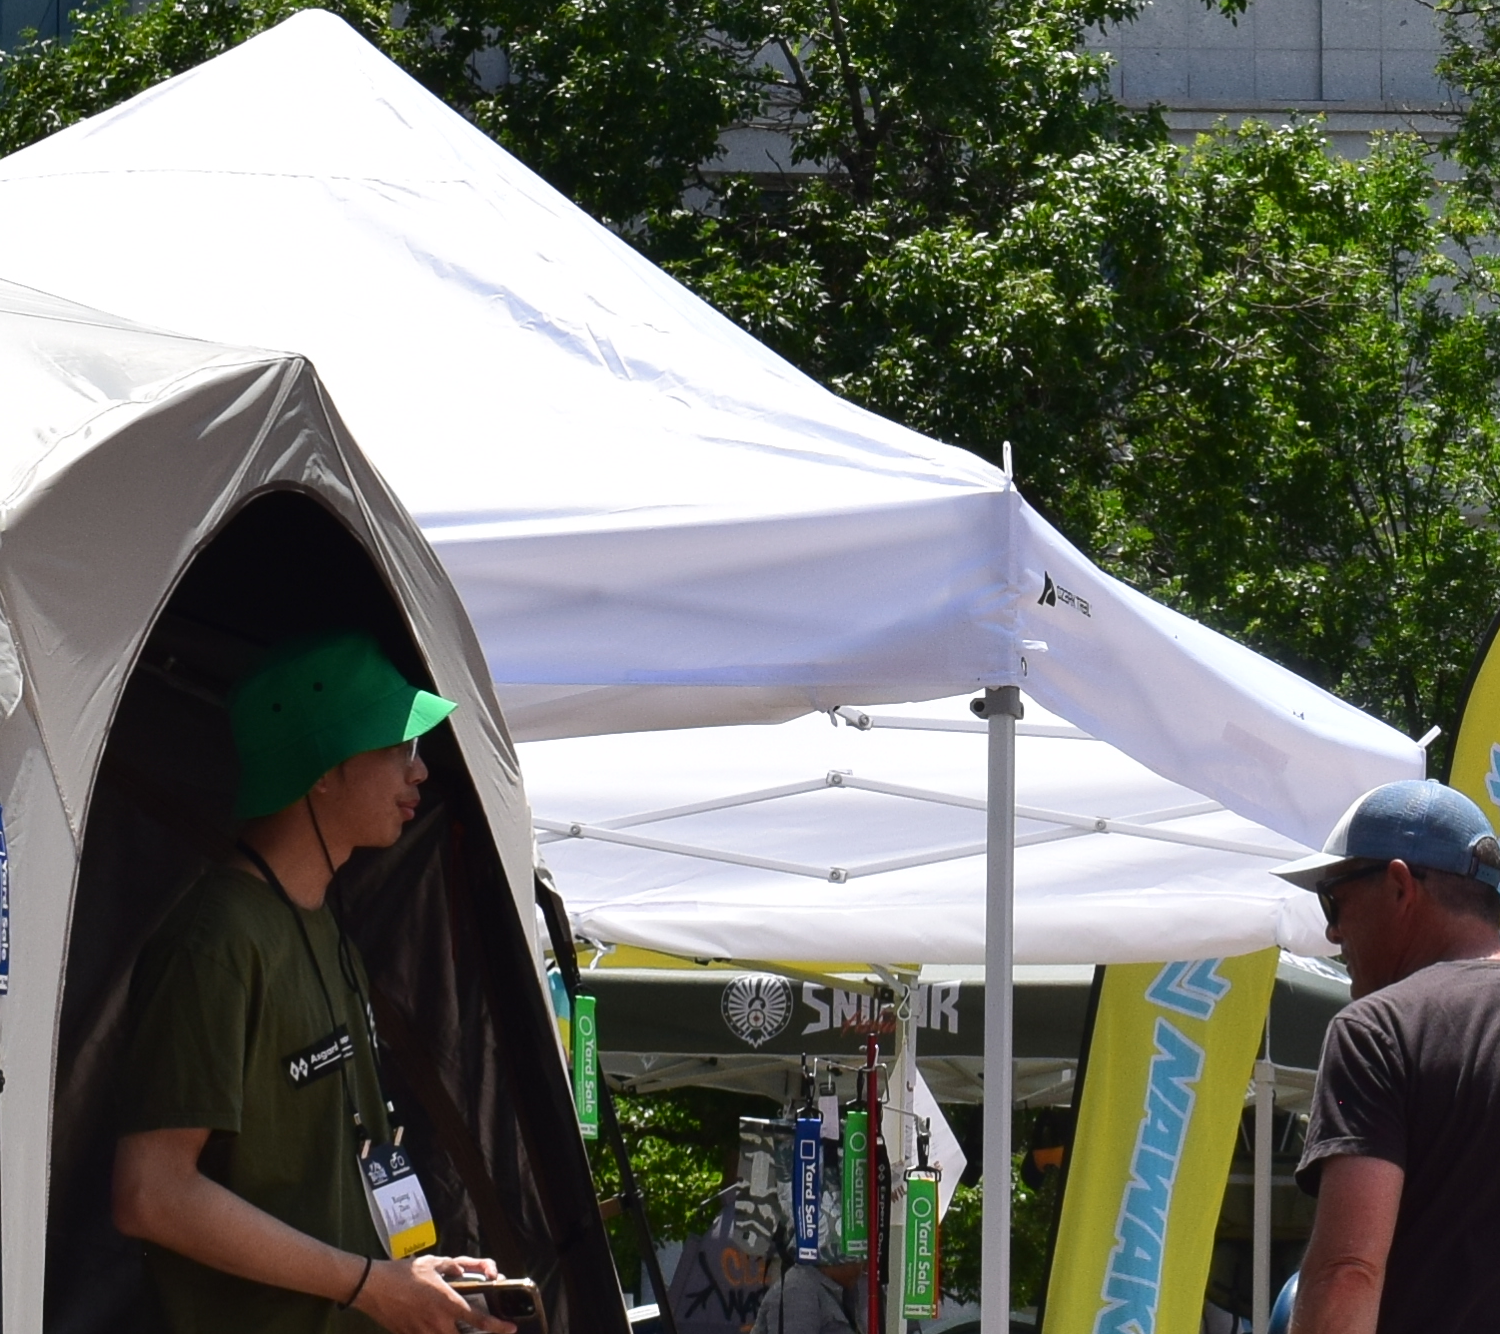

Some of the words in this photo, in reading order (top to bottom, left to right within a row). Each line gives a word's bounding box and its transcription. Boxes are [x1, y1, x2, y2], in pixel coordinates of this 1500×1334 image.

[0, 856, 9, 910] Yard
[0, 918, 9, 961] Sale
[585, 1038, 595, 1076] Yard
[584, 1079, 594, 1115] Sale
[804, 1162, 817, 1200] Yard
[854, 1158, 867, 1228] Learner
[802, 1203, 816, 1239] Sale
[917, 1220, 932, 1257] Yard
[915, 1260, 928, 1295] Sale
